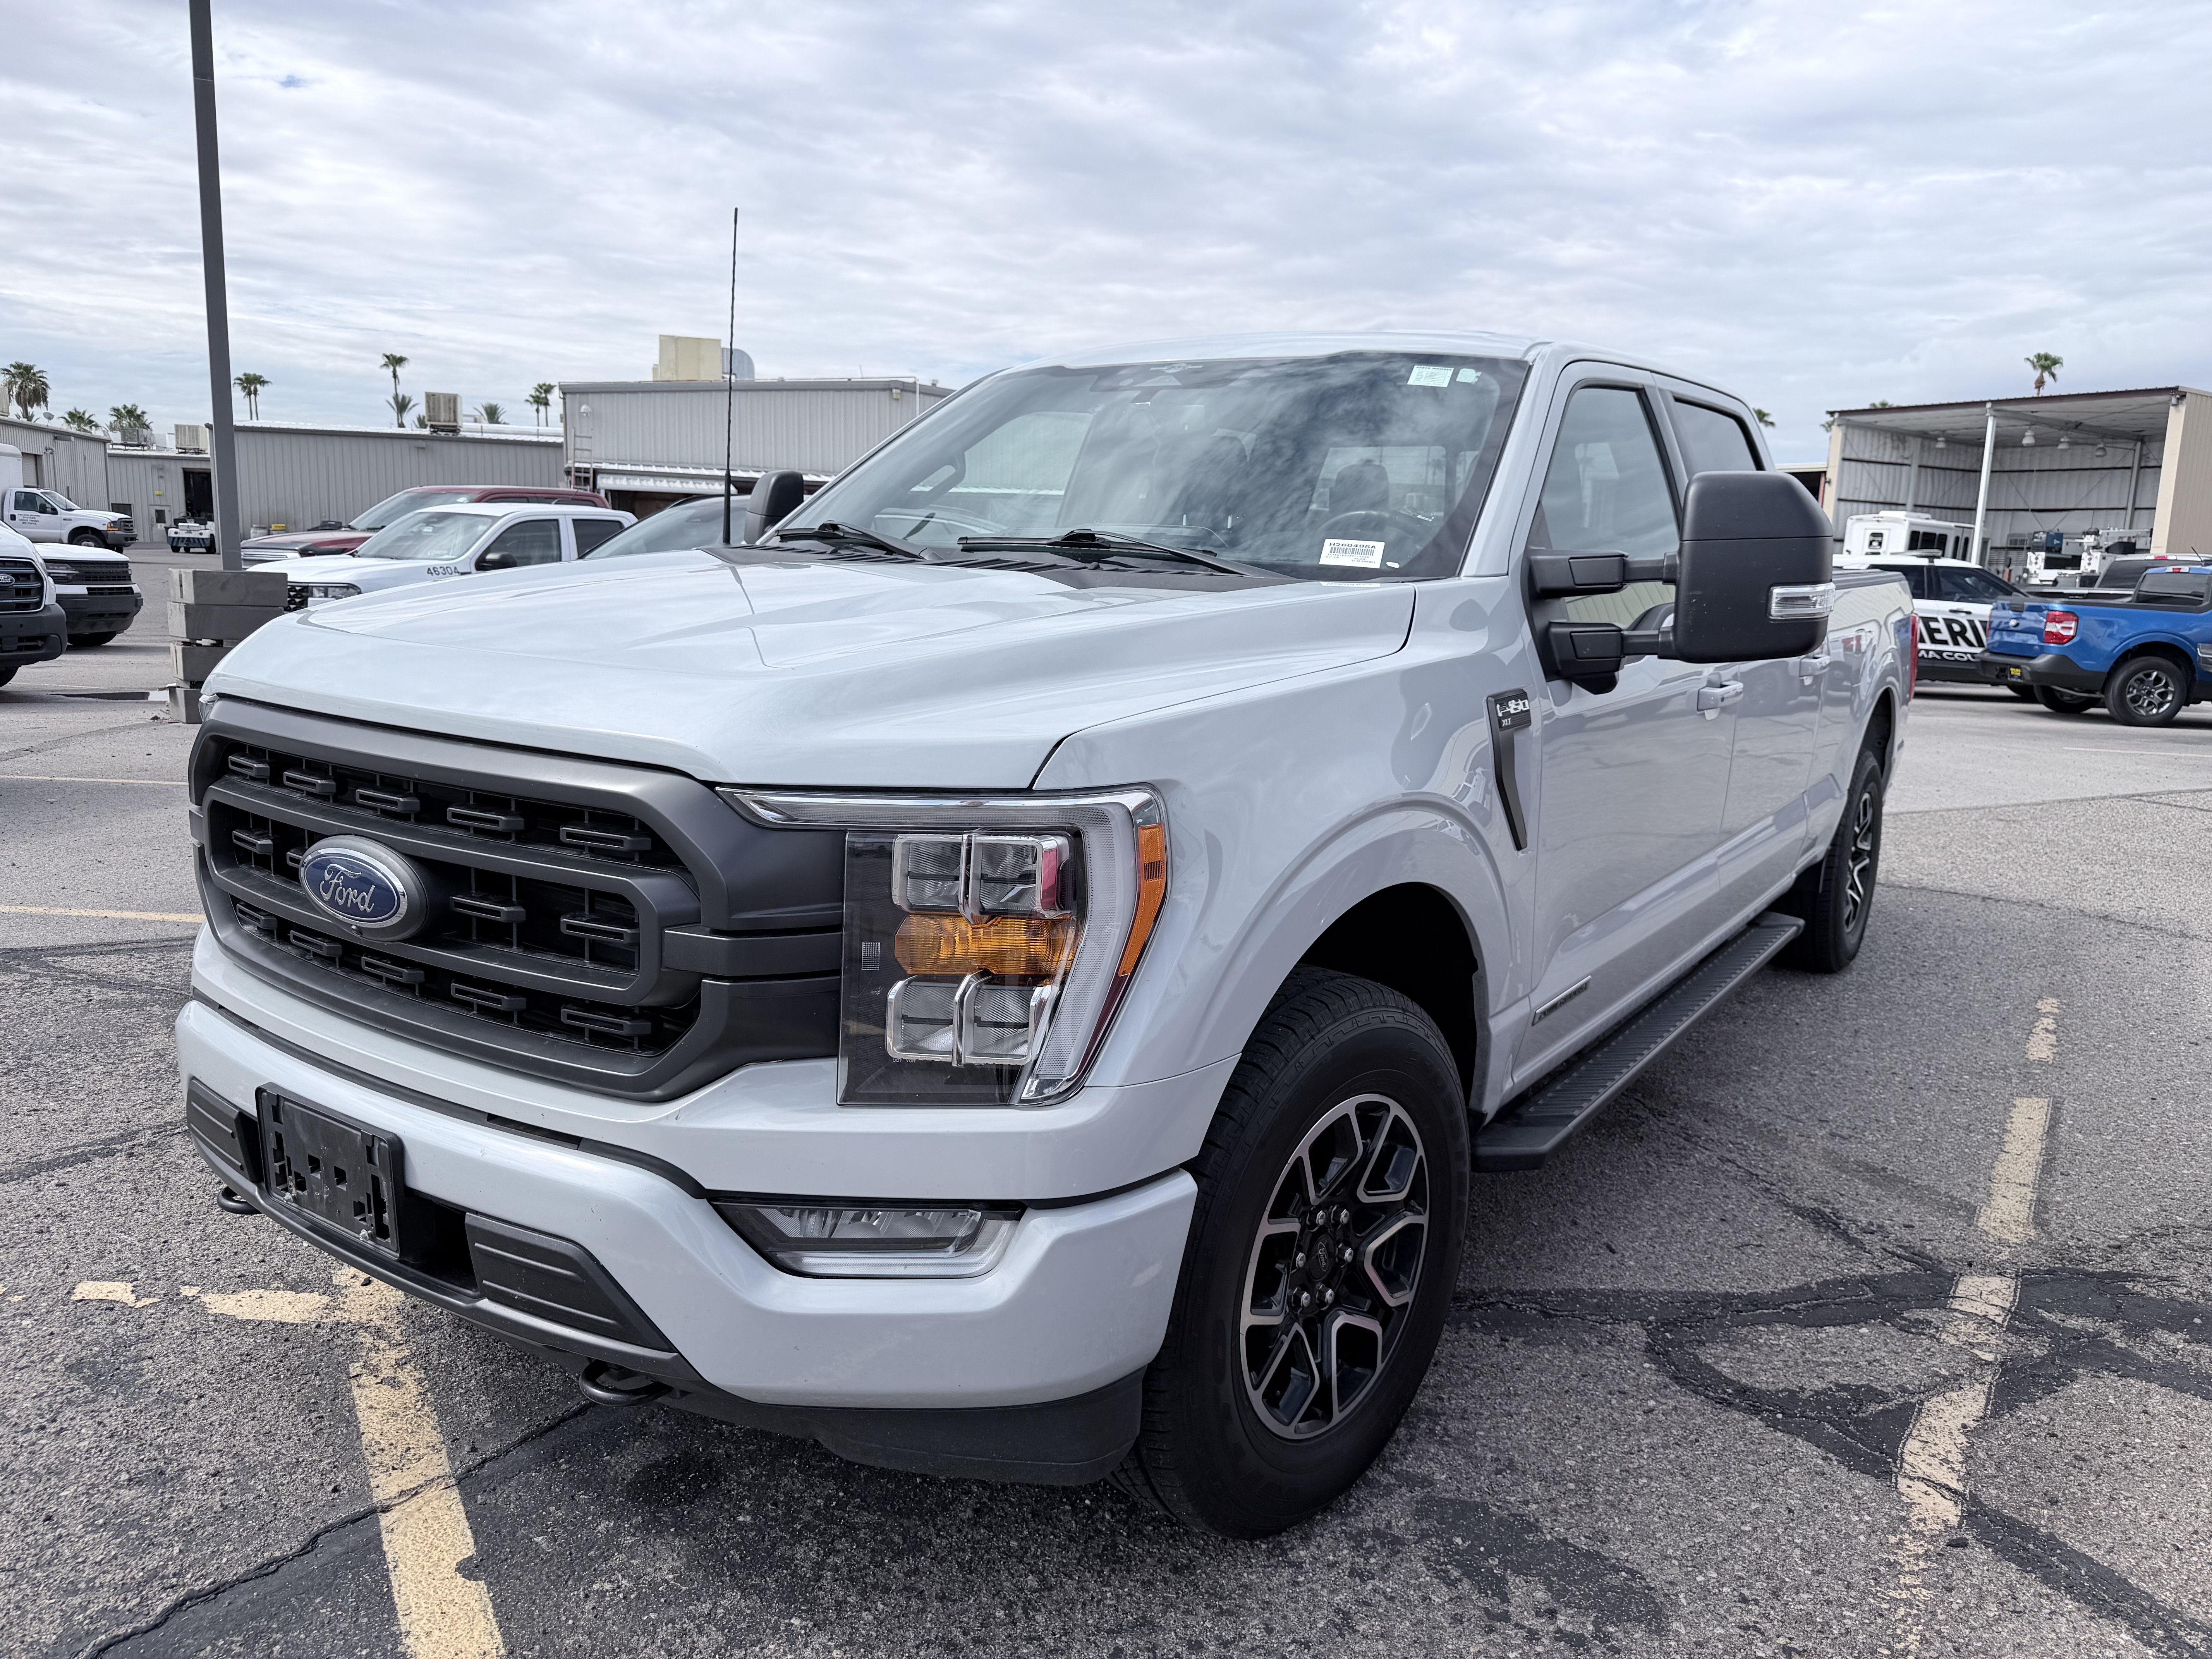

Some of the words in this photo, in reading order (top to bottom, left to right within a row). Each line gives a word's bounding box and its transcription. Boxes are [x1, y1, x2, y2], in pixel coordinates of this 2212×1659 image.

[427, 566, 460, 576] 46304
[1502, 718, 1511, 727] XLT
[319, 863, 376, 913] Ford
[1319, 1248, 1328, 1267] Ford
